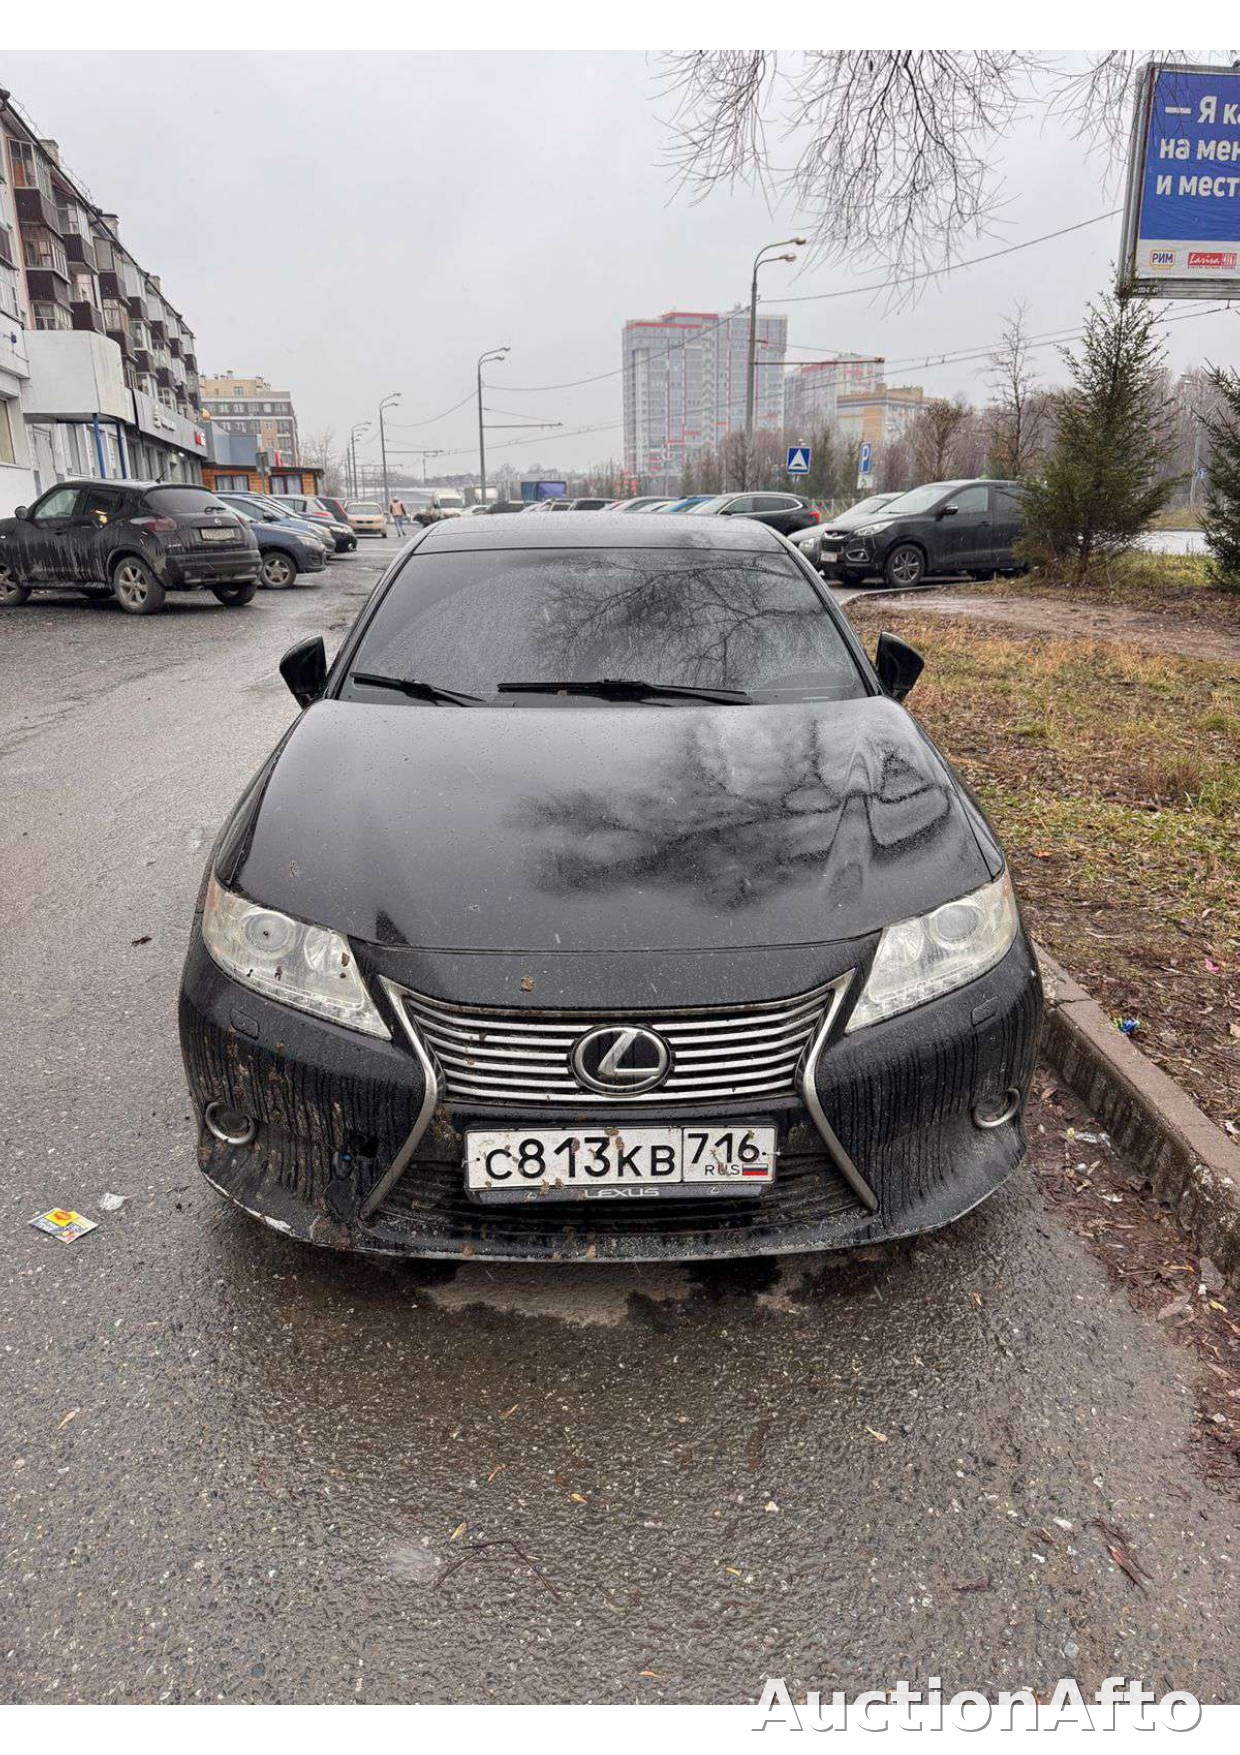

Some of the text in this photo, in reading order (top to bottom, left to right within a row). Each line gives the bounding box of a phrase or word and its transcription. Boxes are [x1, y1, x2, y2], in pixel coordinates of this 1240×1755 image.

[1197, 95, 1218, 124] Я
[1222, 103, 1240, 125] к
[1159, 137, 1191, 161] на
[1156, 173, 1172, 196] и
[1151, 252, 1174, 264] РИМ
[687, 1132, 760, 1164] 716
[704, 1164, 740, 1176] RUS
[583, 1187, 660, 1199] LEXUS
